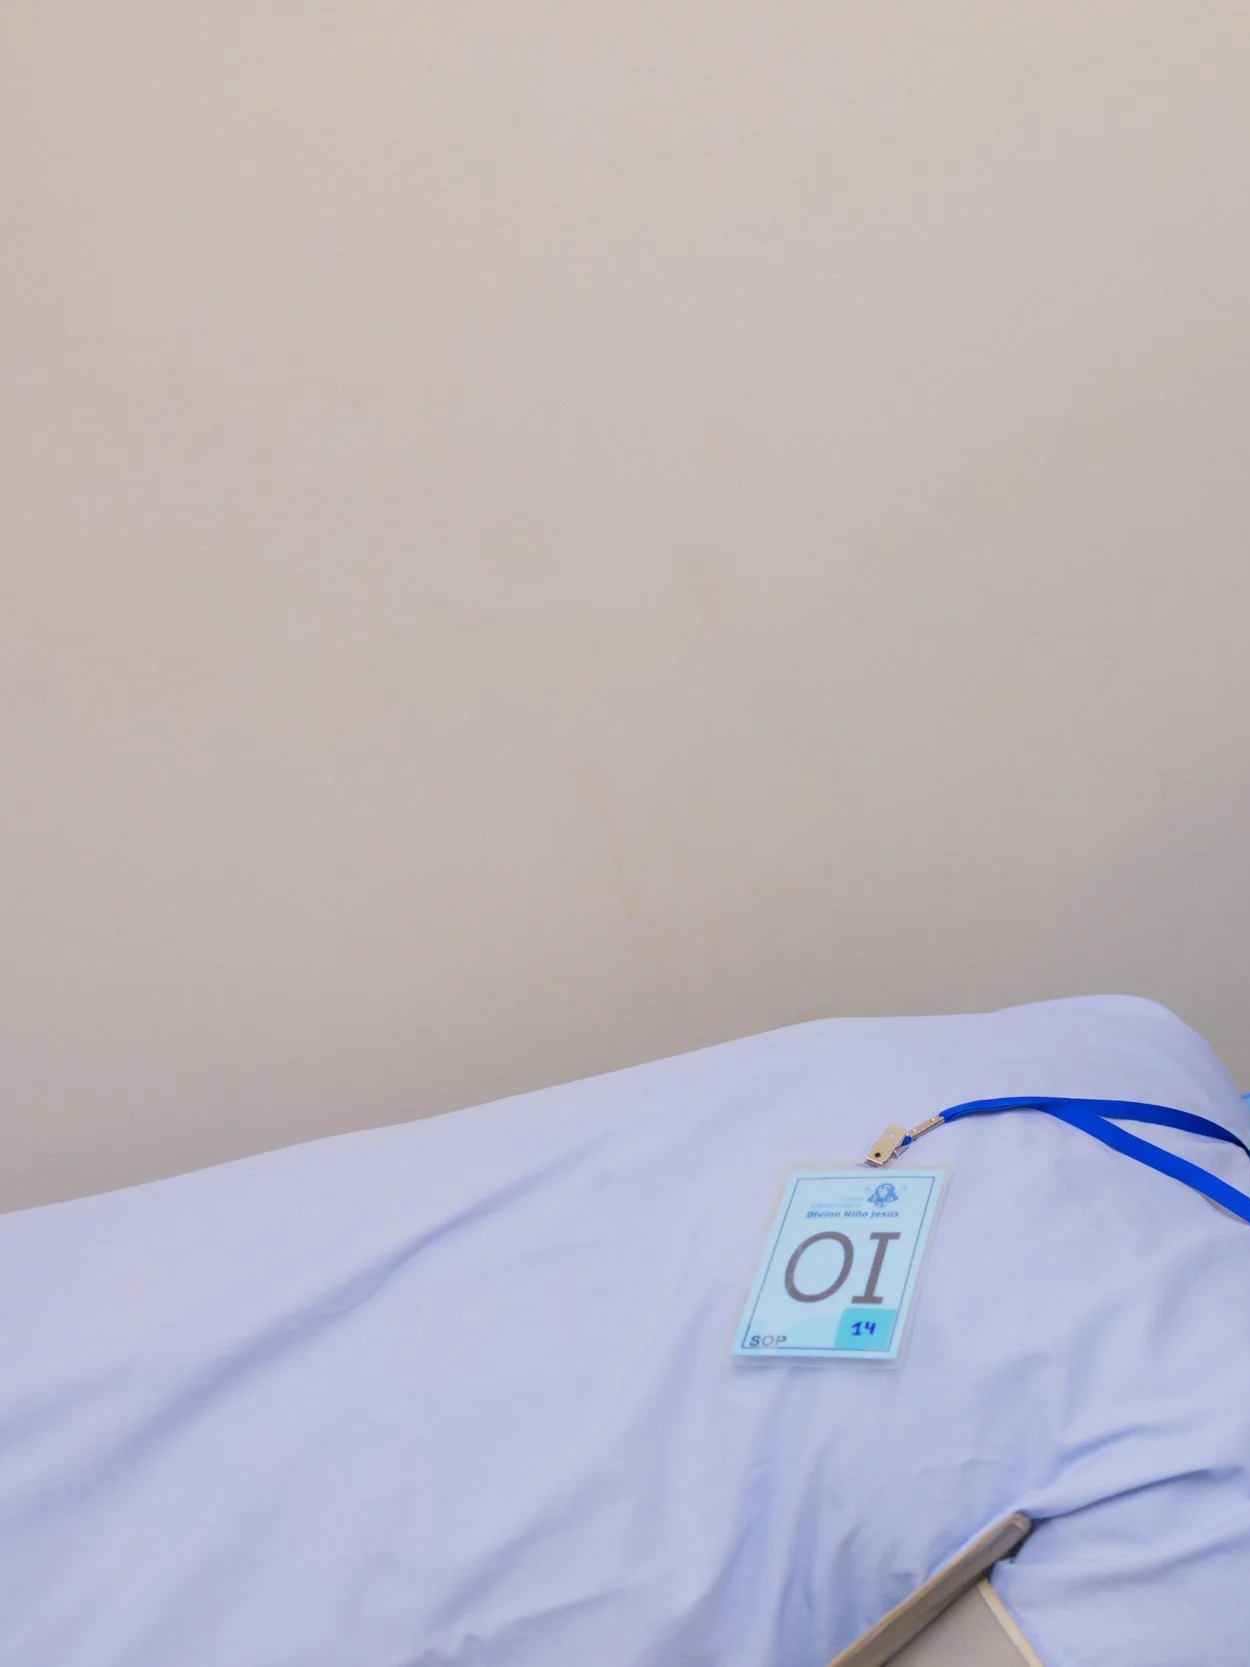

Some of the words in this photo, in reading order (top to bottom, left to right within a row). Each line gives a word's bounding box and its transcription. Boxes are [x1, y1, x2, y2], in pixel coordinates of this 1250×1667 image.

[806, 1210, 841, 1219] Divino
[844, 1210, 868, 1218] Niño
[784, 1231, 901, 1304] OI
[851, 1321, 876, 1336] 14
[749, 1335, 787, 1347] SOP
